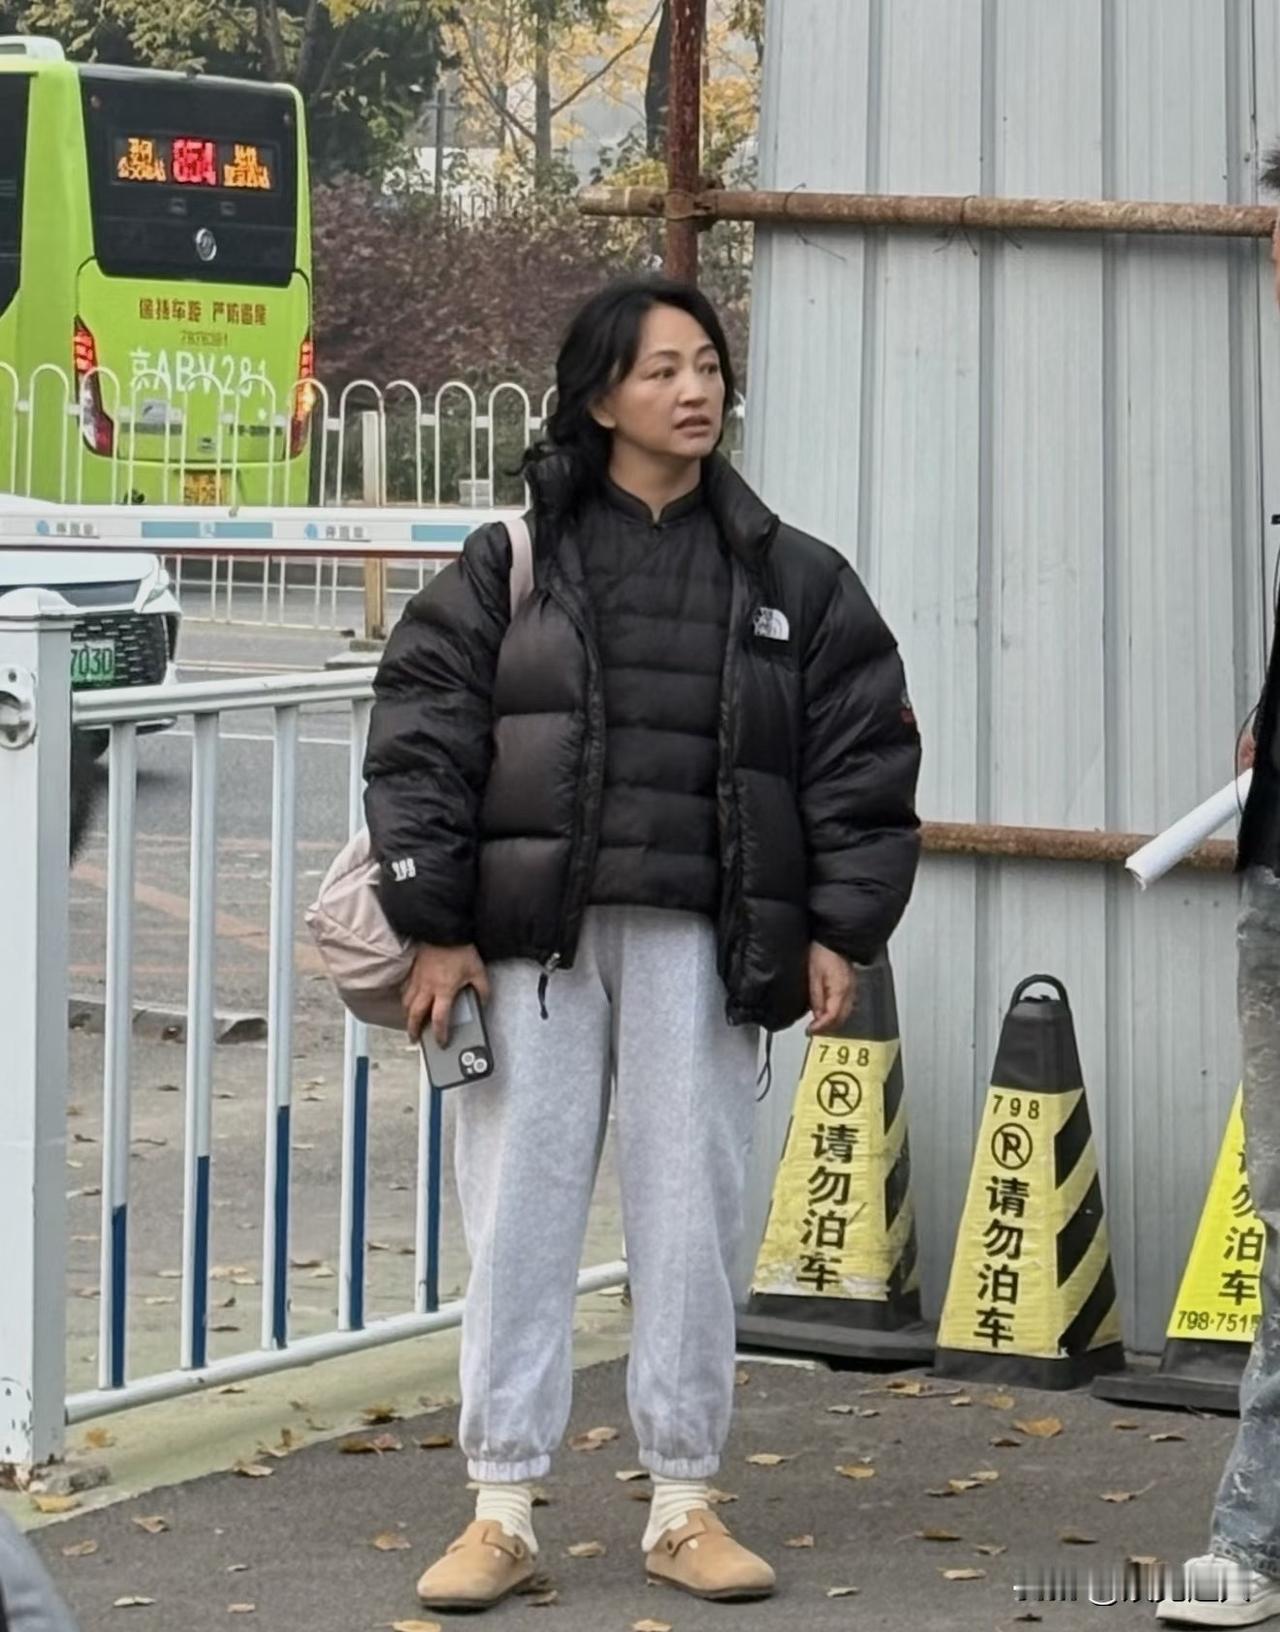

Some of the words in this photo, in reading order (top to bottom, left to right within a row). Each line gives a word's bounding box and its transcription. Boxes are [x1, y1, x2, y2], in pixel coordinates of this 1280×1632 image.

[818, 1044, 870, 1067] 798
[992, 1094, 1041, 1120] 798
[796, 1123, 859, 1292] 请勿泊车
[973, 1175, 1031, 1348] 请勿泊车
